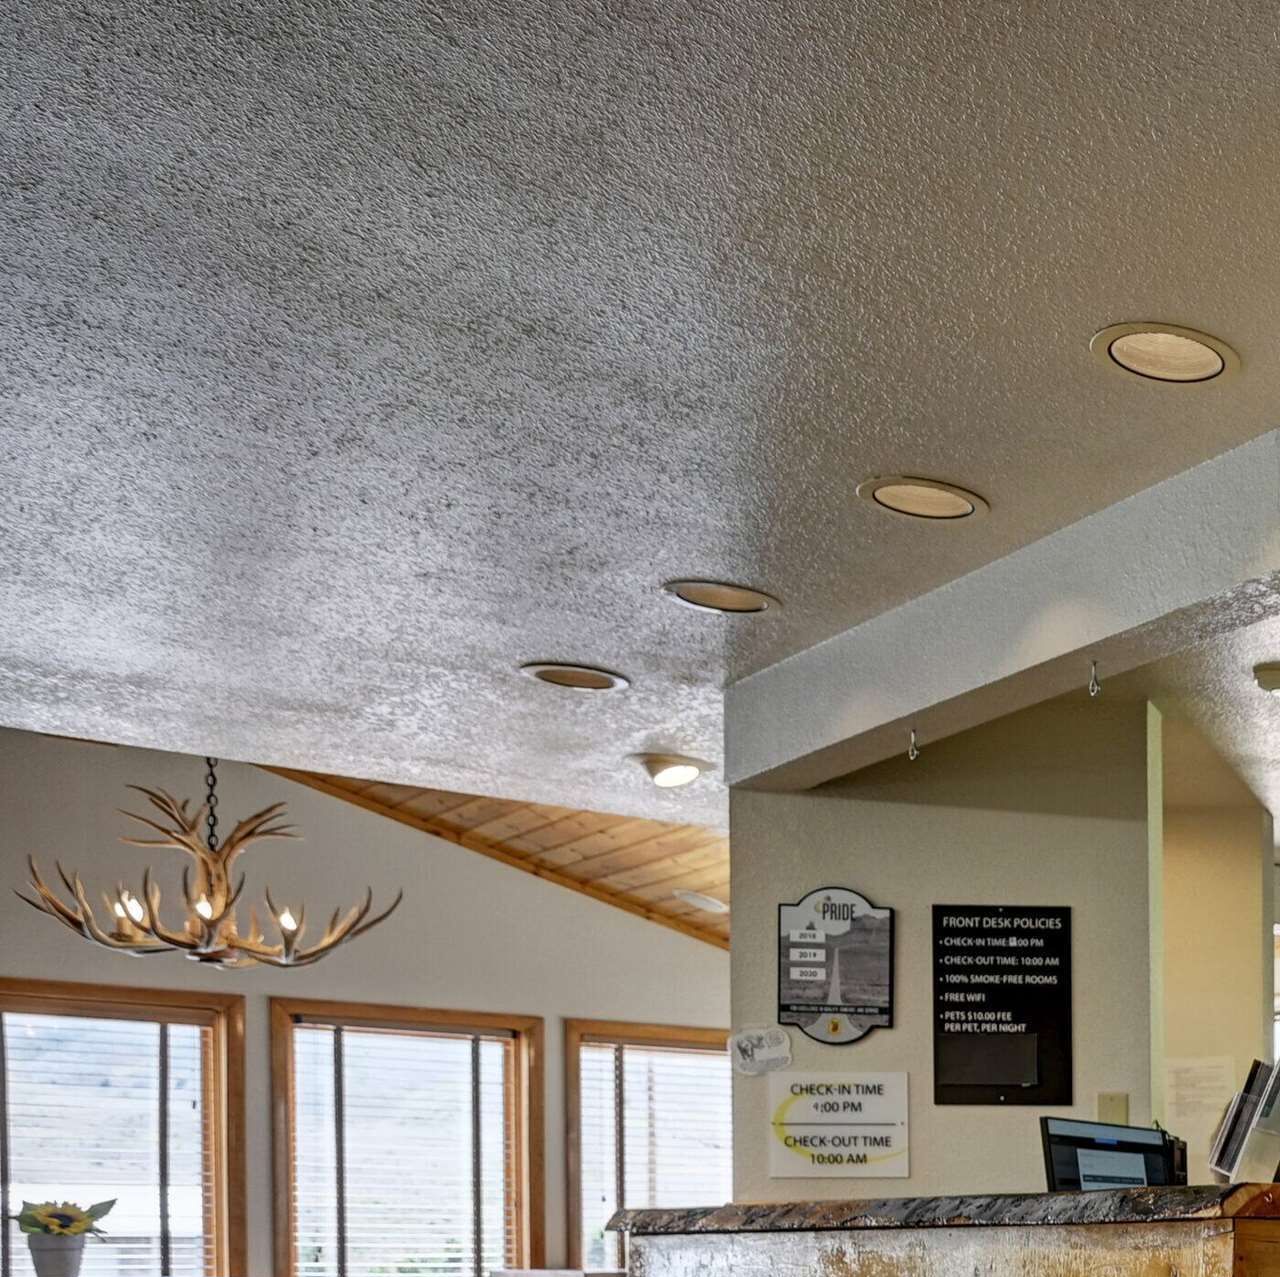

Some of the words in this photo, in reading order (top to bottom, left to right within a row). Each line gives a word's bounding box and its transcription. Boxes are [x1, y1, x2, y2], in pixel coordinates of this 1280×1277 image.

[822, 903, 856, 921] PRIDE
[943, 917, 980, 928] FRONT
[983, 918, 1011, 928] DESK
[1014, 918, 1062, 929] POLICIES
[944, 937, 985, 946] CHECK-IN
[1030, 938, 1044, 946] PM
[944, 956, 994, 965] CHECK-OUT
[996, 956, 1018, 965] TIME:
[1021, 957, 1043, 965] 10:00
[1045, 957, 1059, 966] AM
[945, 974, 968, 984] 100%
[970, 974, 1023, 984] SMOKE-FREE
[1025, 975, 1058, 984] ROOMS
[944, 992, 965, 1002] FREE
[944, 1011, 965, 1020] PETS
[997, 1012, 1012, 1021] FEE
[944, 1023, 961, 1032] PER
[981, 1023, 998, 1032] PER
[999, 1024, 1027, 1032] NIGHT
[790, 1084, 850, 1095] CHECK-IN
[855, 1084, 884, 1095] TIME
[843, 1102, 862, 1112] PM
[784, 1136, 858, 1147] CHECK-OUT
[863, 1136, 892, 1147] TIME
[811, 1154, 843, 1164] 10:00
[846, 1154, 867, 1164] AM
